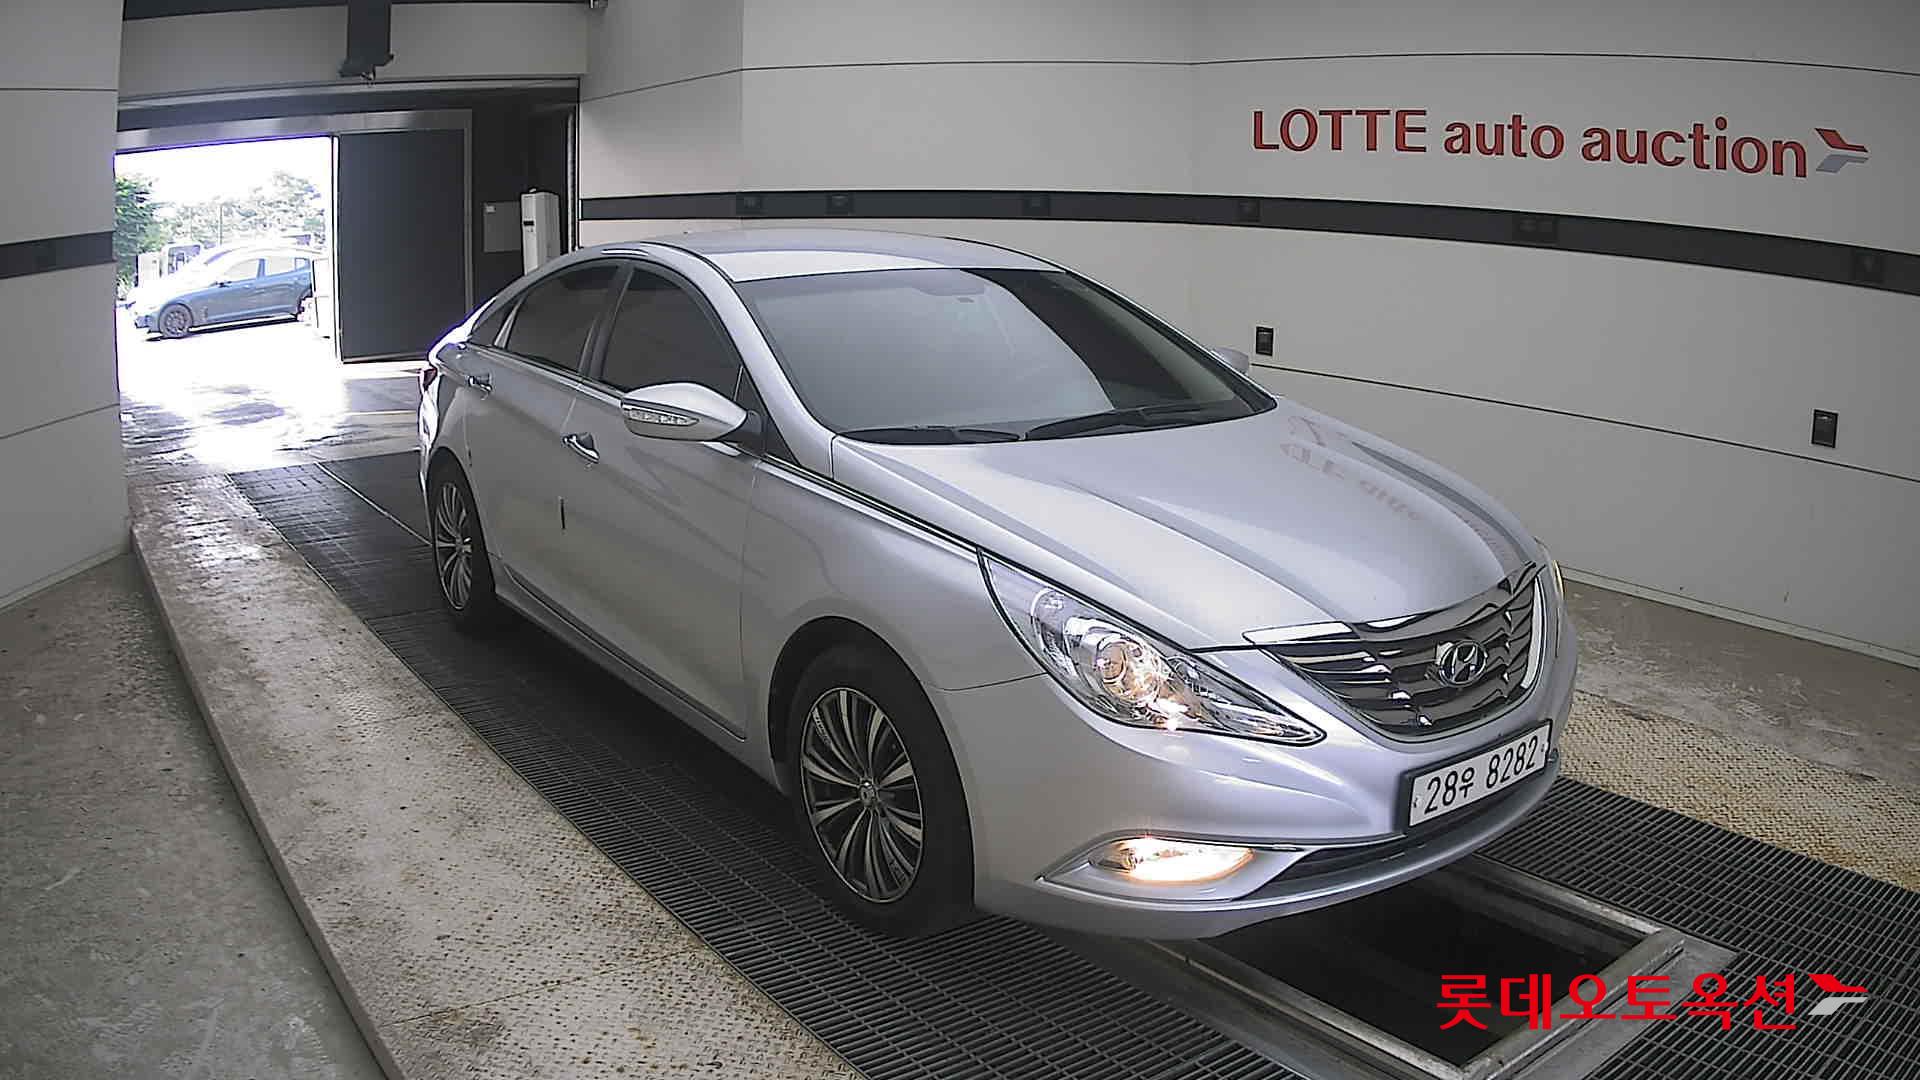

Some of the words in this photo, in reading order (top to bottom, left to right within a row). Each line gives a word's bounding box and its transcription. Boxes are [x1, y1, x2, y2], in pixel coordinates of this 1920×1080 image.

[1252, 109, 1427, 152] LOTTE
[1443, 114, 1565, 158] auto
[1581, 117, 1807, 178] auction
[1423, 767, 1475, 814] 28우
[1486, 735, 1538, 789] 8282
